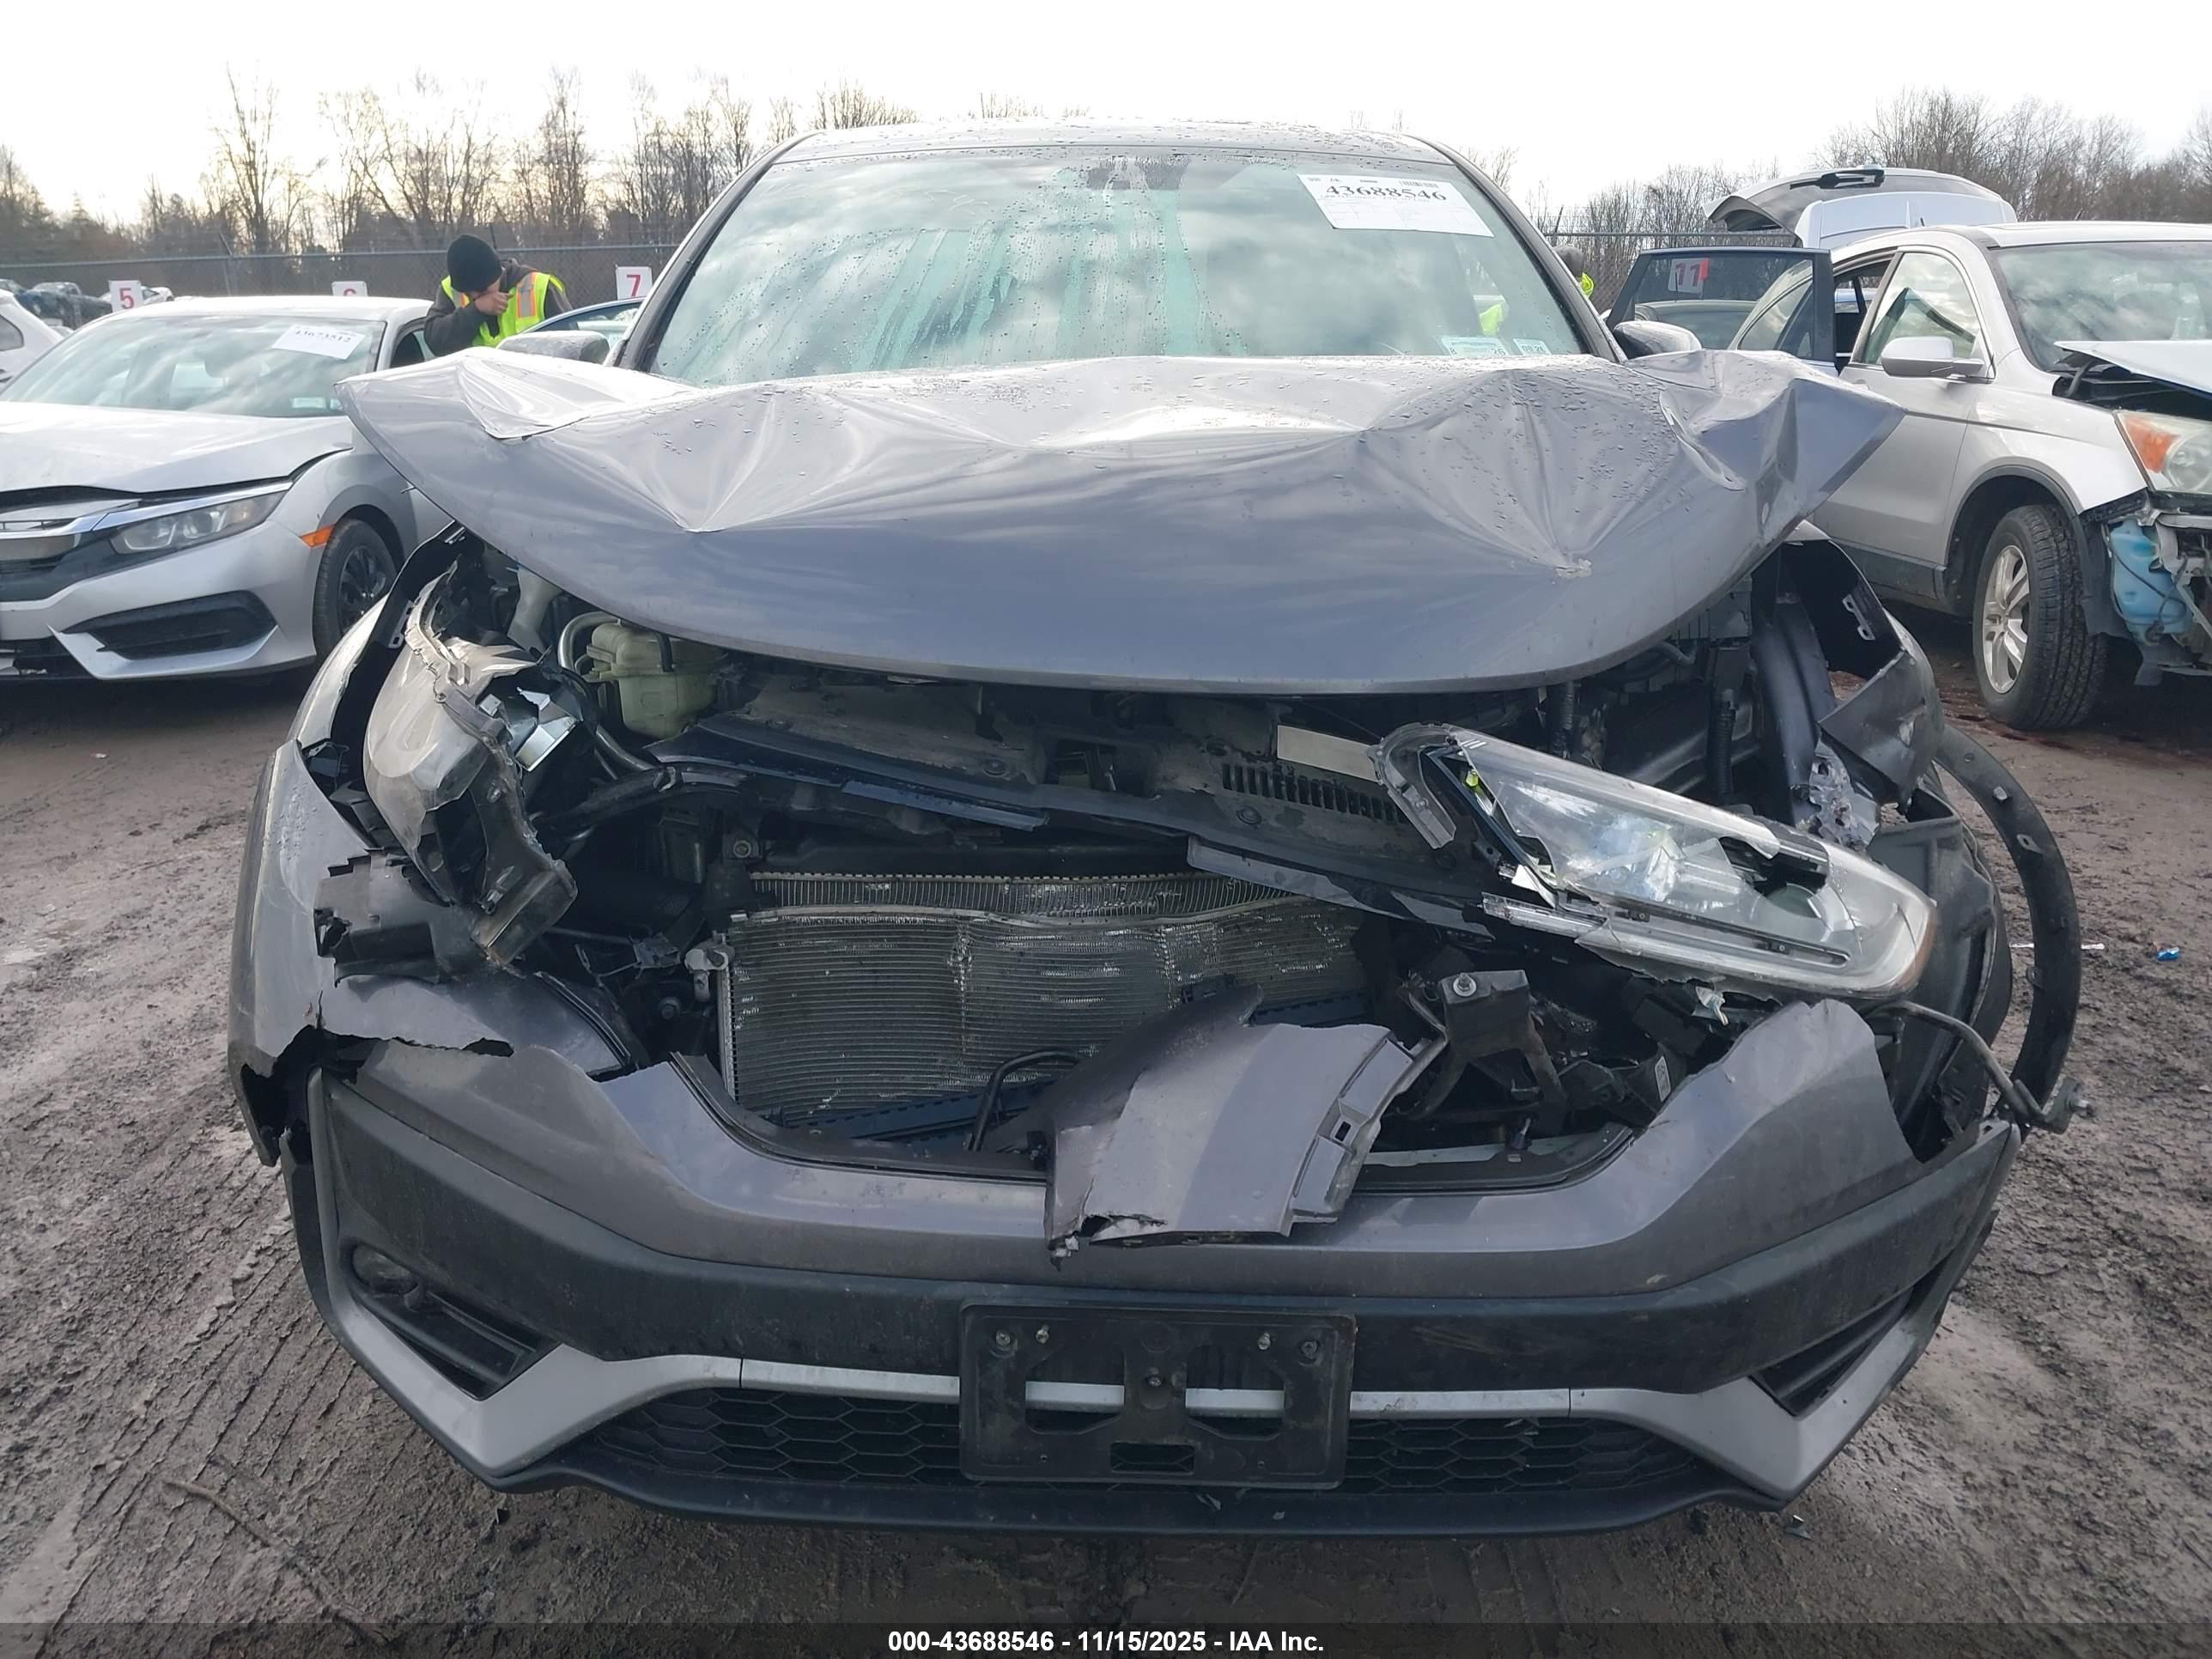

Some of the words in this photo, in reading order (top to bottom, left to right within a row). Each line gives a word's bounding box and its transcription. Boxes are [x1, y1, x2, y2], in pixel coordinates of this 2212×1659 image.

[1326, 185, 1447, 201] 43688546
[1675, 261, 1700, 287] 11
[626, 274, 641, 298] 7
[119, 288, 134, 309] 5
